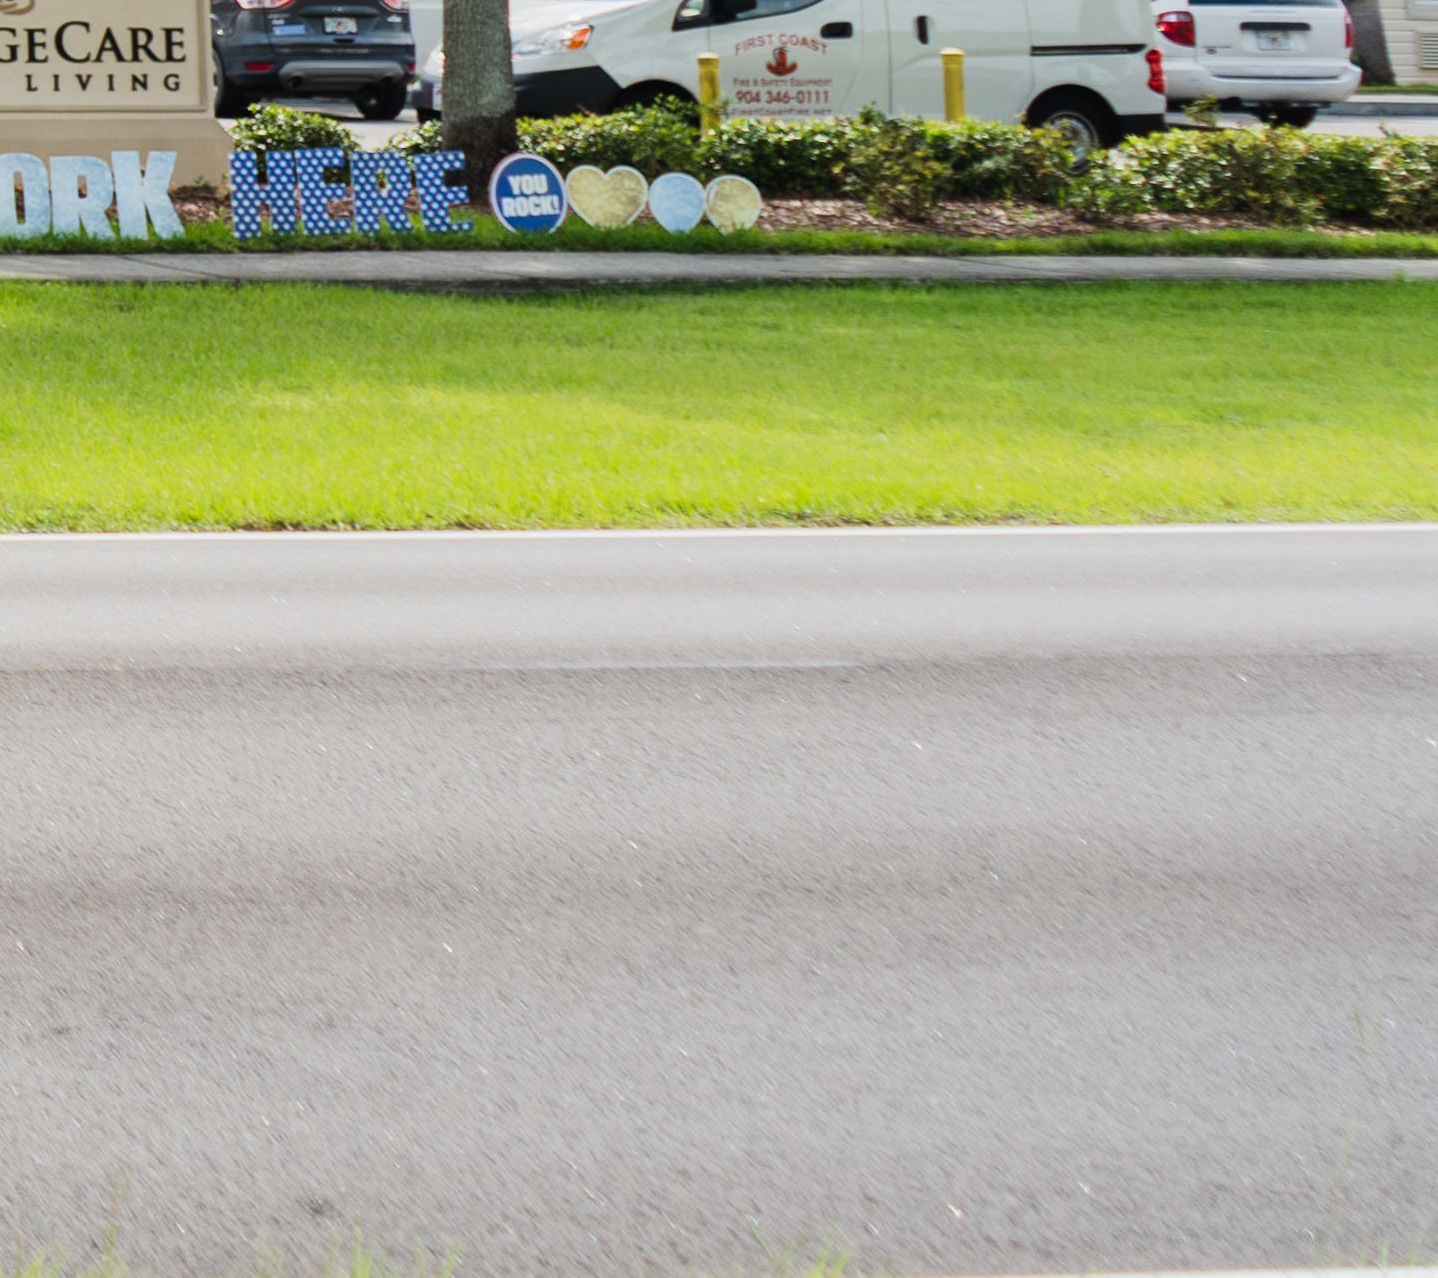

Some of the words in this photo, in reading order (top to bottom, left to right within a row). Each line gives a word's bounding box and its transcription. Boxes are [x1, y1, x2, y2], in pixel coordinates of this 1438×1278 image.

[735, 34, 774, 56] FIRST
[779, 33, 828, 55] COAST
[25, 74, 181, 92] LIVING
[736, 91, 761, 104] 904
[765, 91, 829, 104] 346-0111
[228, 148, 474, 239] HERE
[508, 174, 548, 196] YOU
[501, 195, 560, 218] ROCK!
